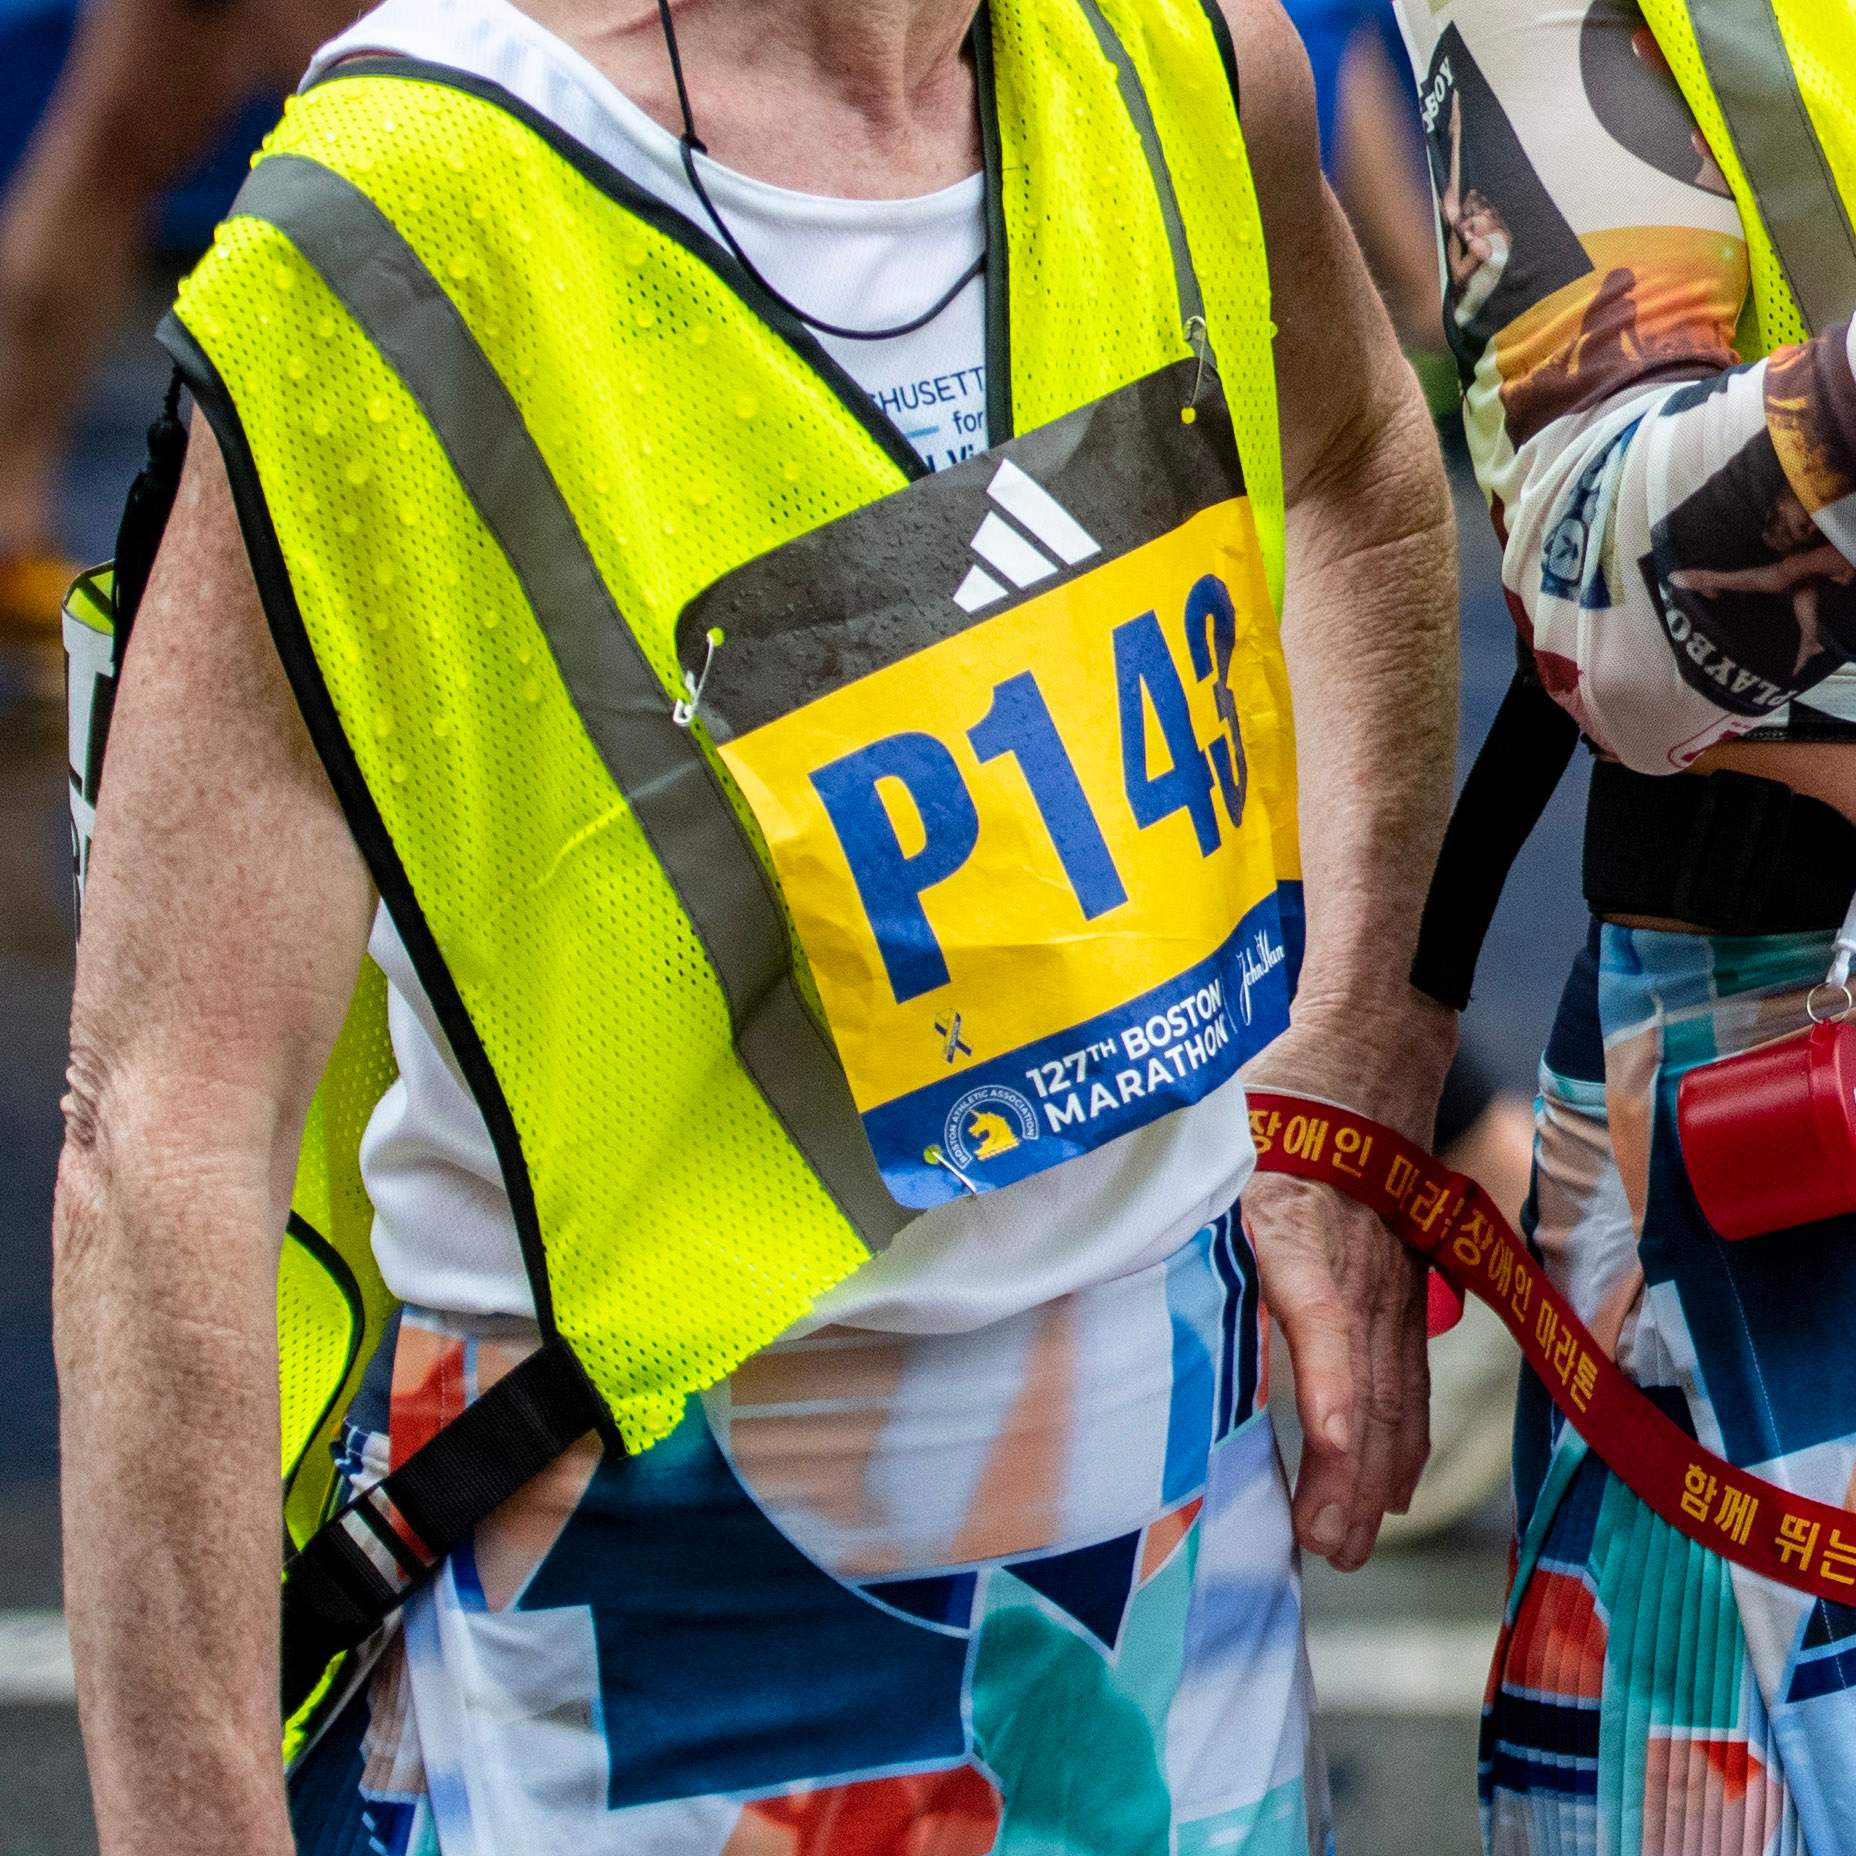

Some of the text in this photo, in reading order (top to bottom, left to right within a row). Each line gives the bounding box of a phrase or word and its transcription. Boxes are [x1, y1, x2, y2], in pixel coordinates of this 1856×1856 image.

[871, 366, 984, 416] HUSETT
[953, 409, 984, 435] for
[808, 574, 1248, 1005] P143
[1025, 978, 1222, 1098] 127TH BOSTON
[1043, 1014, 1229, 1133] MARATHON
[948, 1088, 1035, 1164] BOSTON ATHLETIC ASSOCIATION
[1534, 1299, 1599, 1414] 마라톤
[1680, 1462, 1759, 1545] 함께
